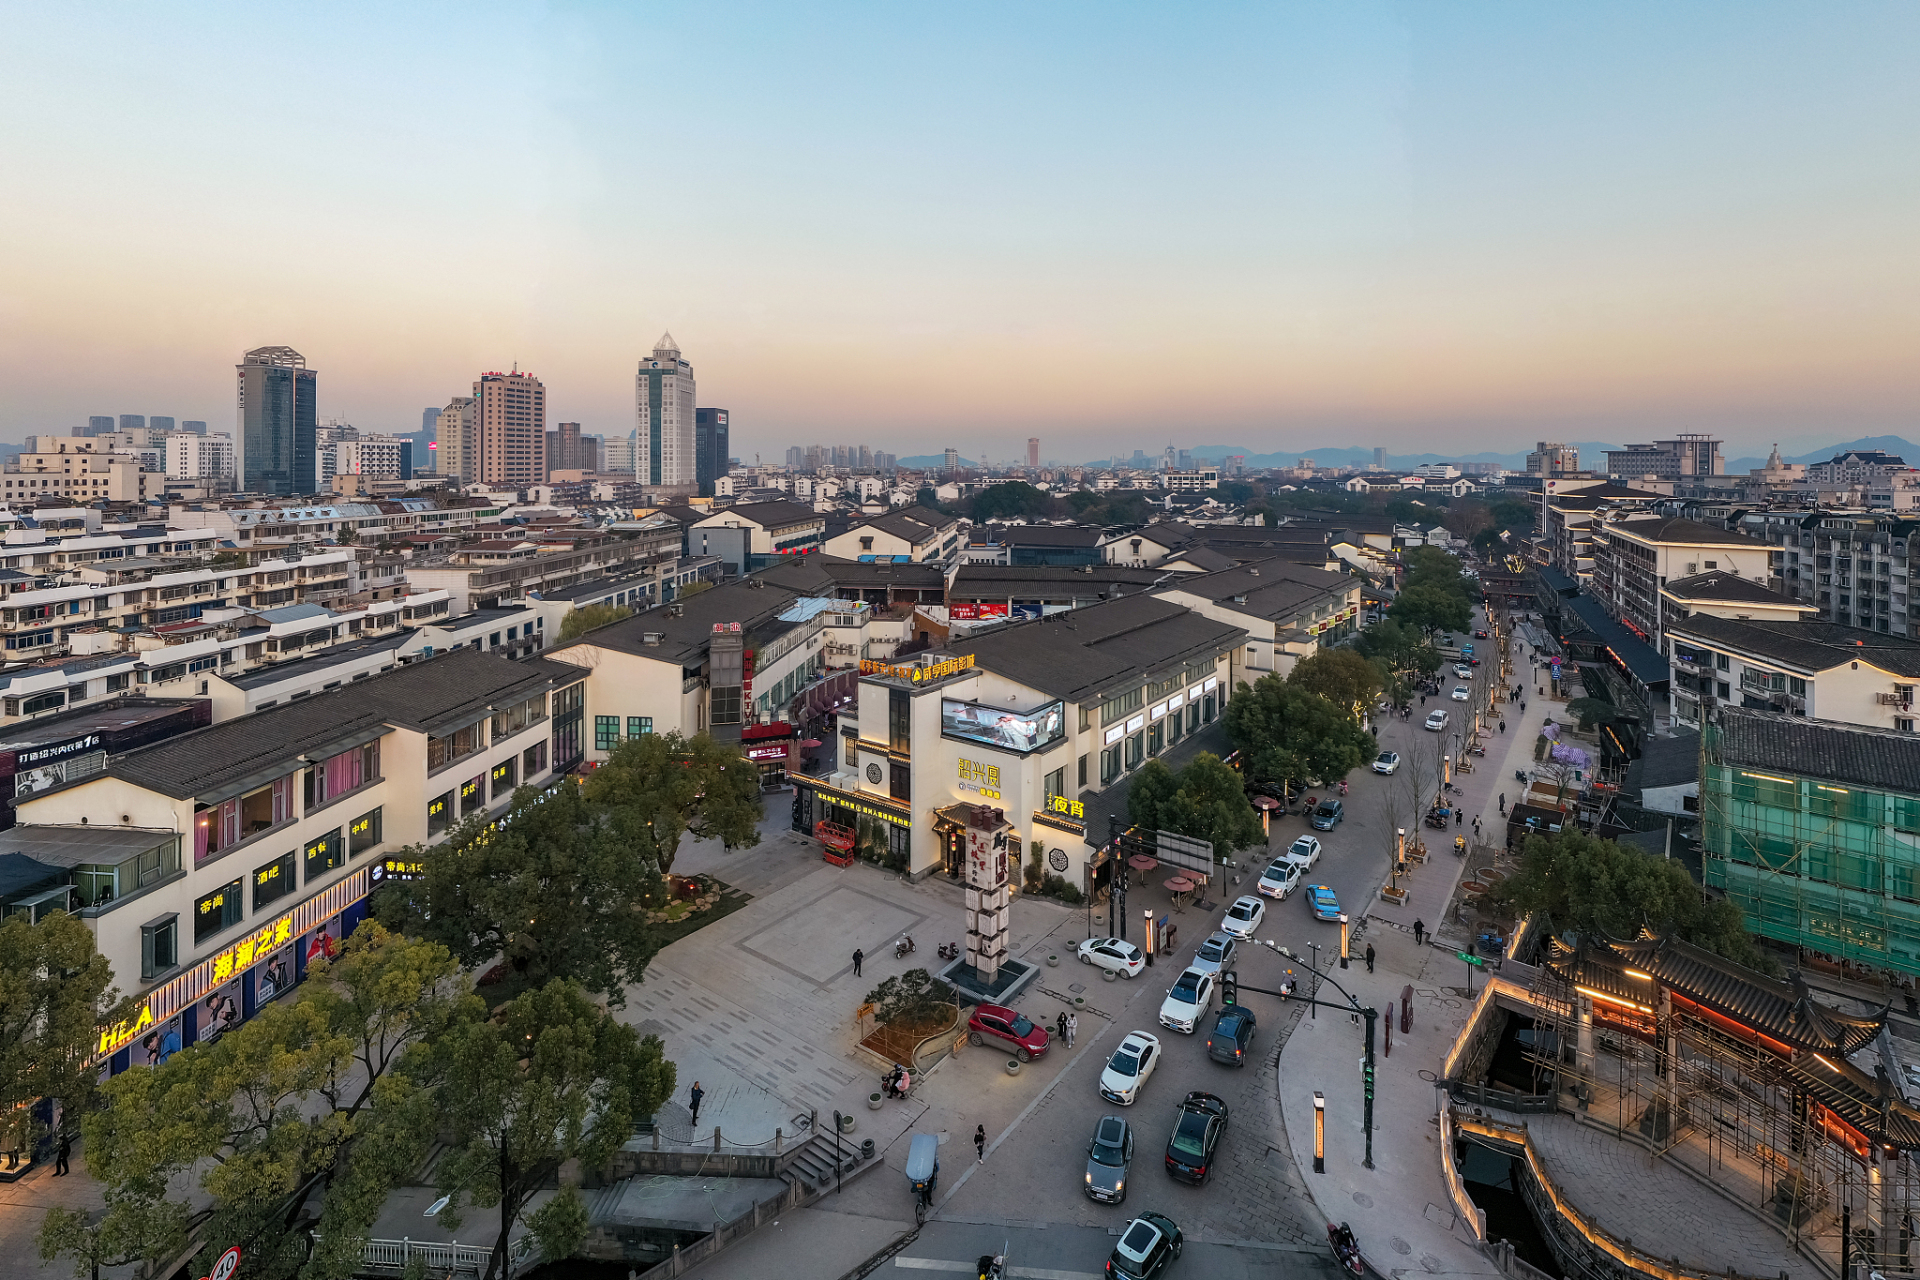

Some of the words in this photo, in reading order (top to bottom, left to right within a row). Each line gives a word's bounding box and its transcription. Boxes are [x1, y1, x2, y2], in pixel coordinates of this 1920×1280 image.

[923, 654, 975, 681] 咸亨国际影城
[1054, 795, 1084, 818] 夜宵
[257, 865, 280, 886] 酒吧
[200, 894, 224, 915] 帝尚
[212, 917, 292, 984] 海澜之家
[98, 1005, 154, 1054] HLA
[216, 1255, 234, 1279] 40
